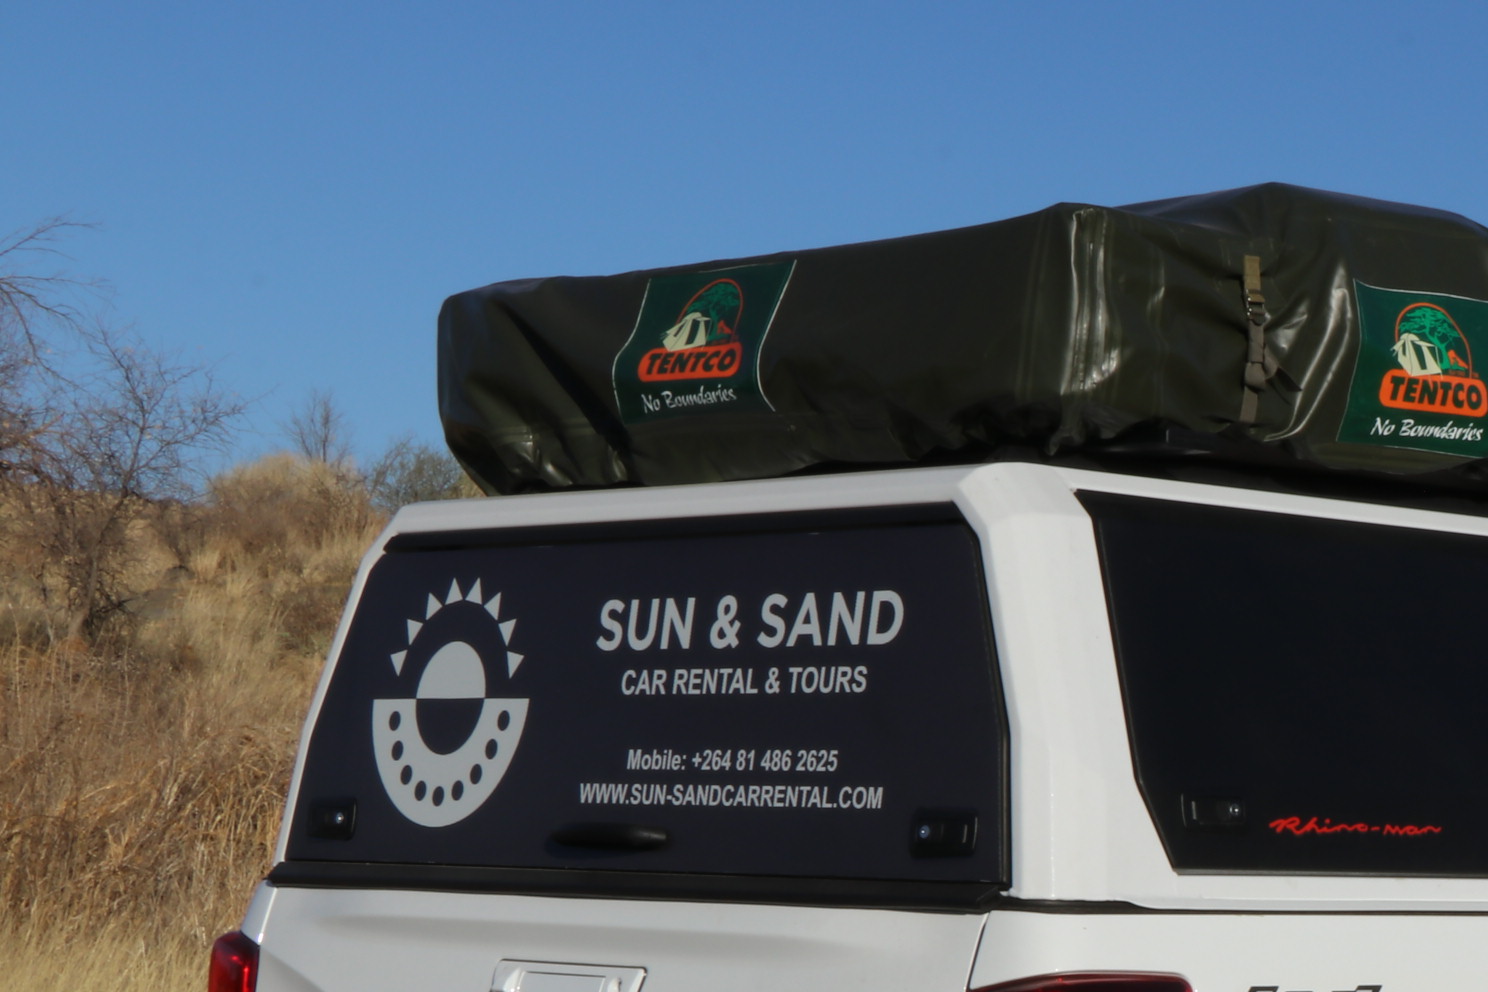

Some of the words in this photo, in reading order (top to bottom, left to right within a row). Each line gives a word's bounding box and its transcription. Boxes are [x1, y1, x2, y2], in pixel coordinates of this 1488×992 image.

[646, 349, 736, 375] TENTCO
[641, 394, 661, 414] No
[661, 384, 737, 409] Boundaries
[1390, 375, 1483, 411] TENTCO
[1370, 417, 1396, 437] No
[1399, 418, 1484, 441] Boundaries
[595, 597, 696, 651] SUN
[709, 594, 742, 650] &
[756, 589, 904, 648] SAND
[621, 668, 667, 696] CAR
[672, 667, 759, 695] RENTAL
[764, 667, 781, 694] &
[788, 665, 868, 694] TOURS
[626, 749, 687, 770] Mobile:
[691, 749, 732, 771] +264
[736, 749, 755, 771] 81
[760, 749, 792, 772] 486
[795, 749, 839, 772] 2625
[579, 782, 883, 809] WWW.SUN-SANDCARRENTAL.COM
